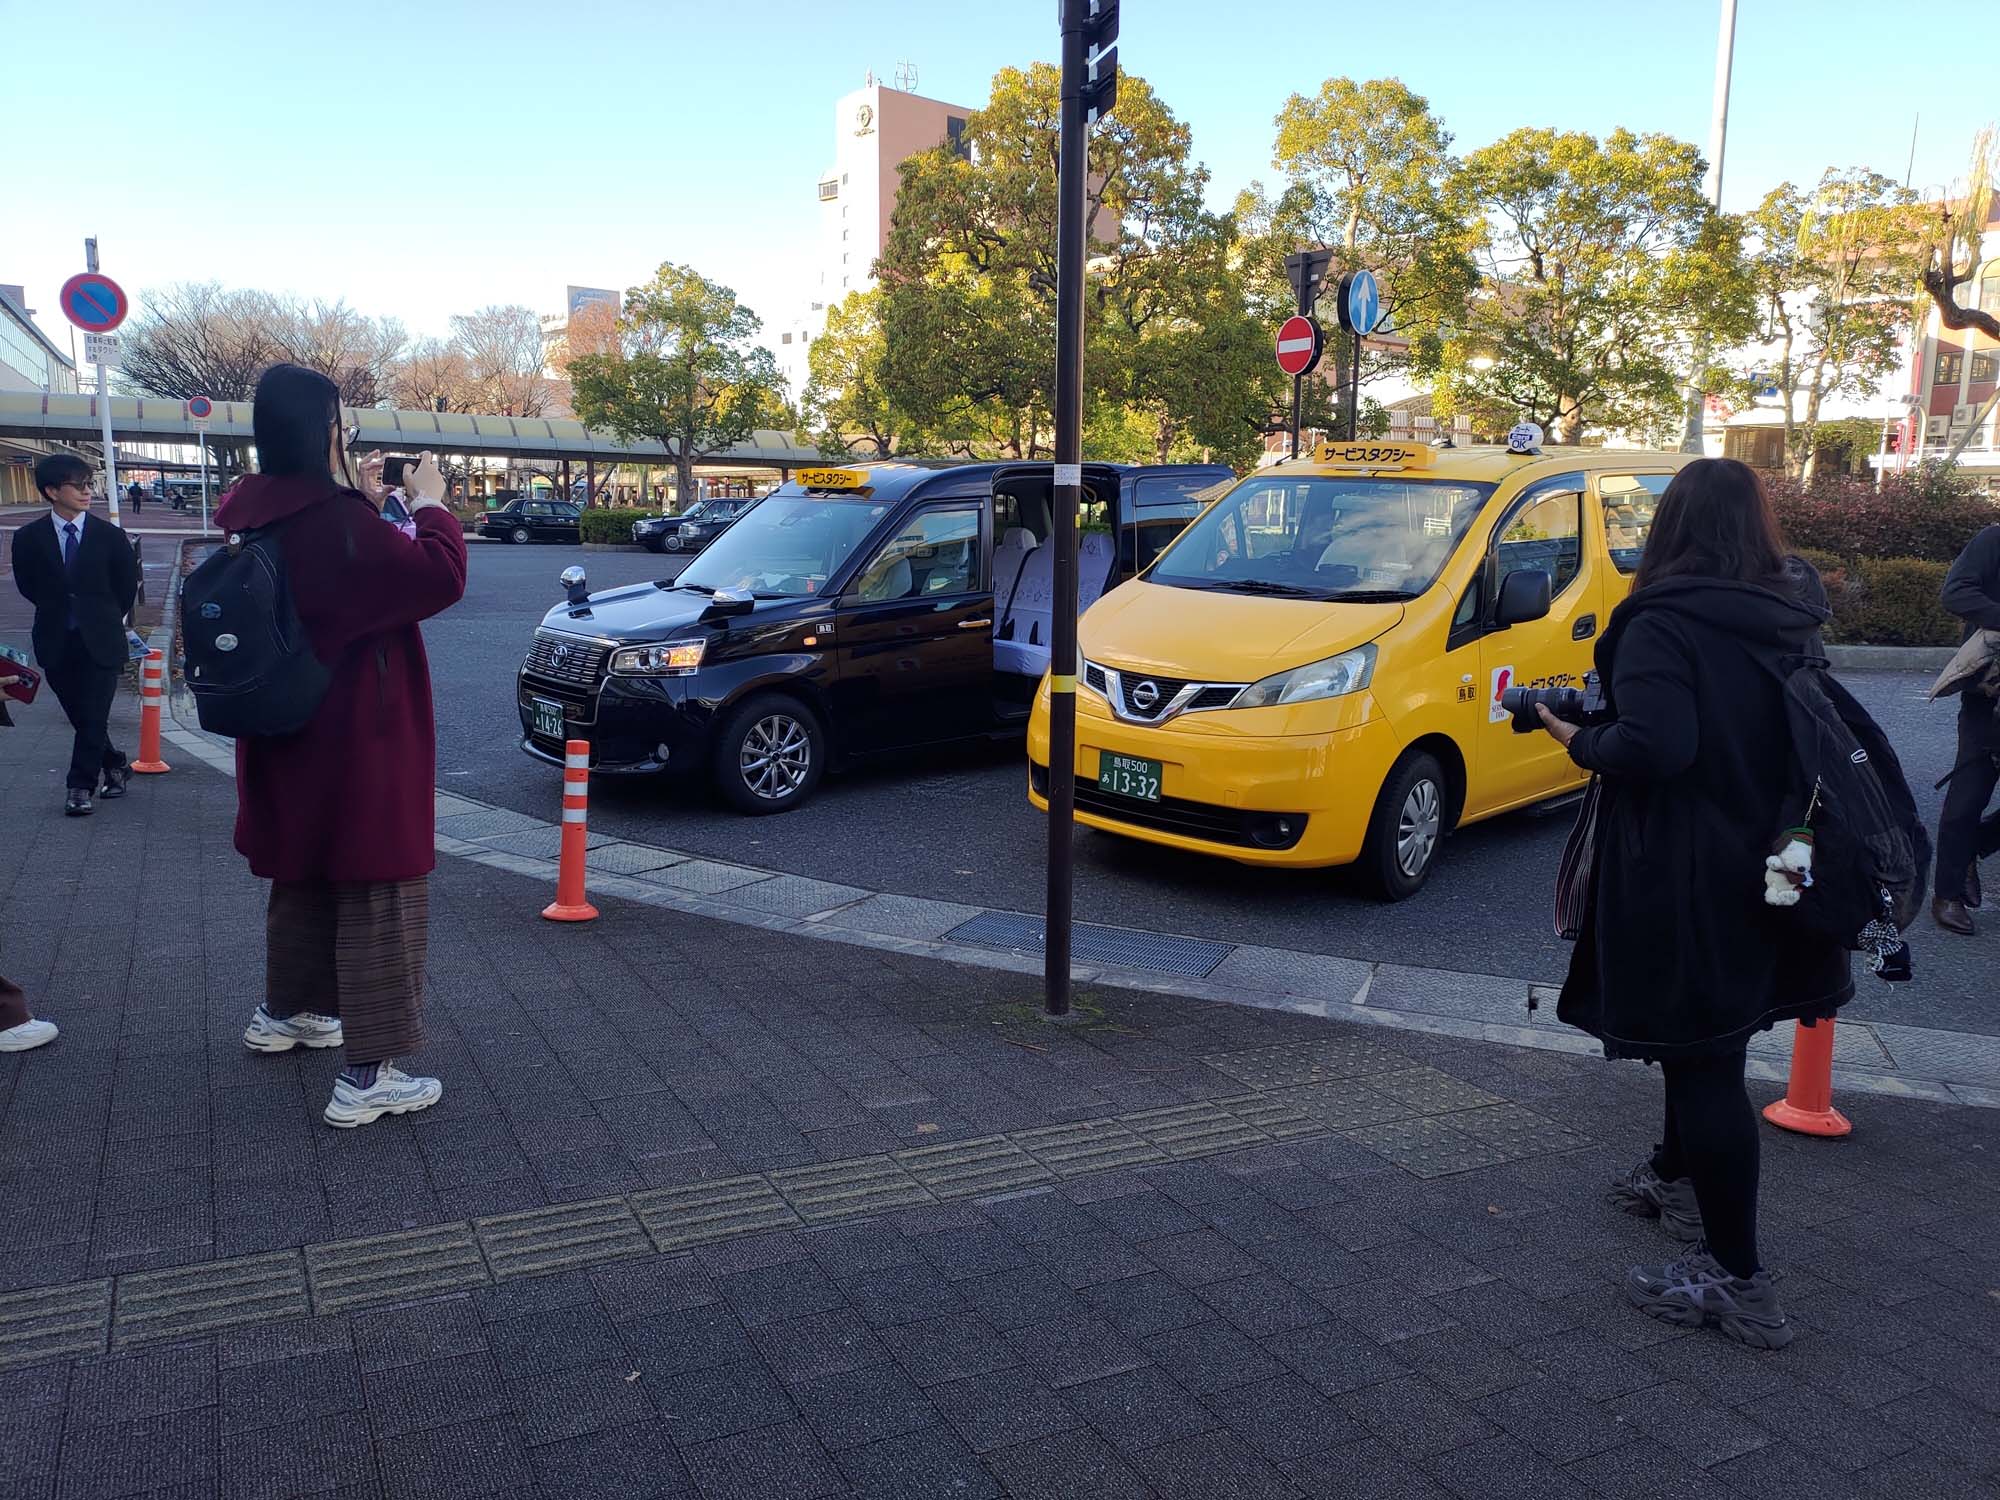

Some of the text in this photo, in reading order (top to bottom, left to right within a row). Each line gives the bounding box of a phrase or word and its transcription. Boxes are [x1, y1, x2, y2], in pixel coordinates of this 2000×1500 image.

[1512, 440, 1526, 449] OK
[1324, 447, 1416, 463] サービスタクシー
[802, 472, 852, 485] サービスタクシー
[1458, 686, 1475, 700] 鳥取
[541, 713, 562, 736] 14-26
[1113, 757, 1148, 774] 鳥取500
[1102, 769, 1158, 800] あ 13-32
